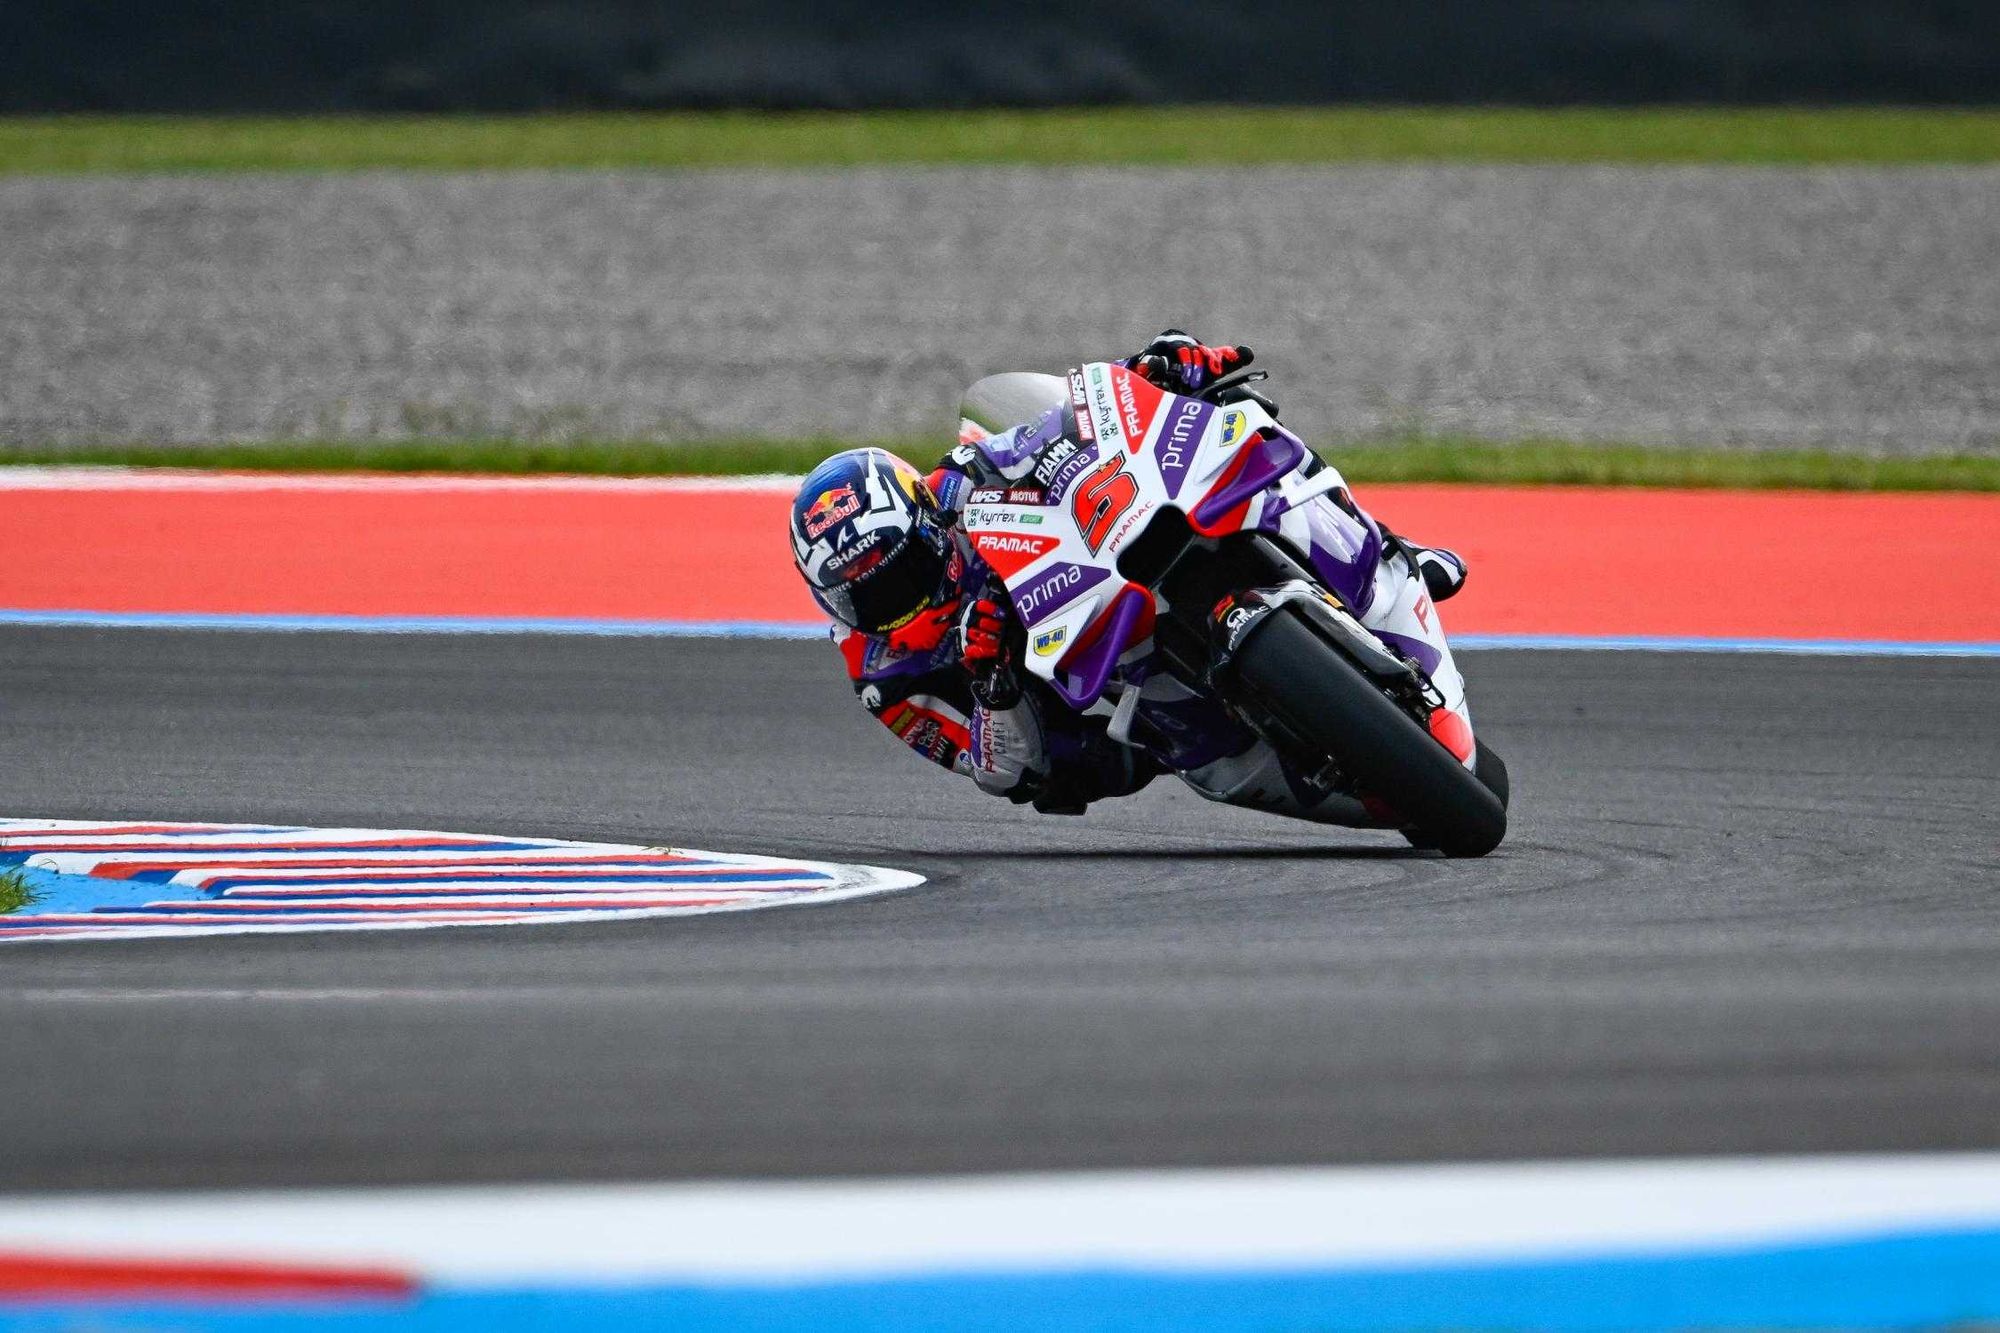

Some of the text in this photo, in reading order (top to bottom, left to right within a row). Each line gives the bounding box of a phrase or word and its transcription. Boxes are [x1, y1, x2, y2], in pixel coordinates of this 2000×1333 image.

[1076, 410, 1093, 439] MOTUL
[1117, 374, 1143, 437] PRAMAC
[1162, 402, 1202, 470] prima
[1035, 439, 1077, 486] FIAMM
[1051, 453, 1091, 501] prima
[833, 496, 862, 526] Bull
[970, 490, 1040, 503] WRS MOTUL
[979, 510, 1016, 526] kyrrex
[1071, 450, 1140, 559] 5
[978, 535, 1043, 554] PRAMAC
[1108, 500, 1155, 552] PRAMAC
[826, 531, 881, 571] SHARK
[1016, 564, 1081, 621] prima
[1036, 630, 1064, 649] WD-40
[982, 708, 997, 773] PRAMAC
